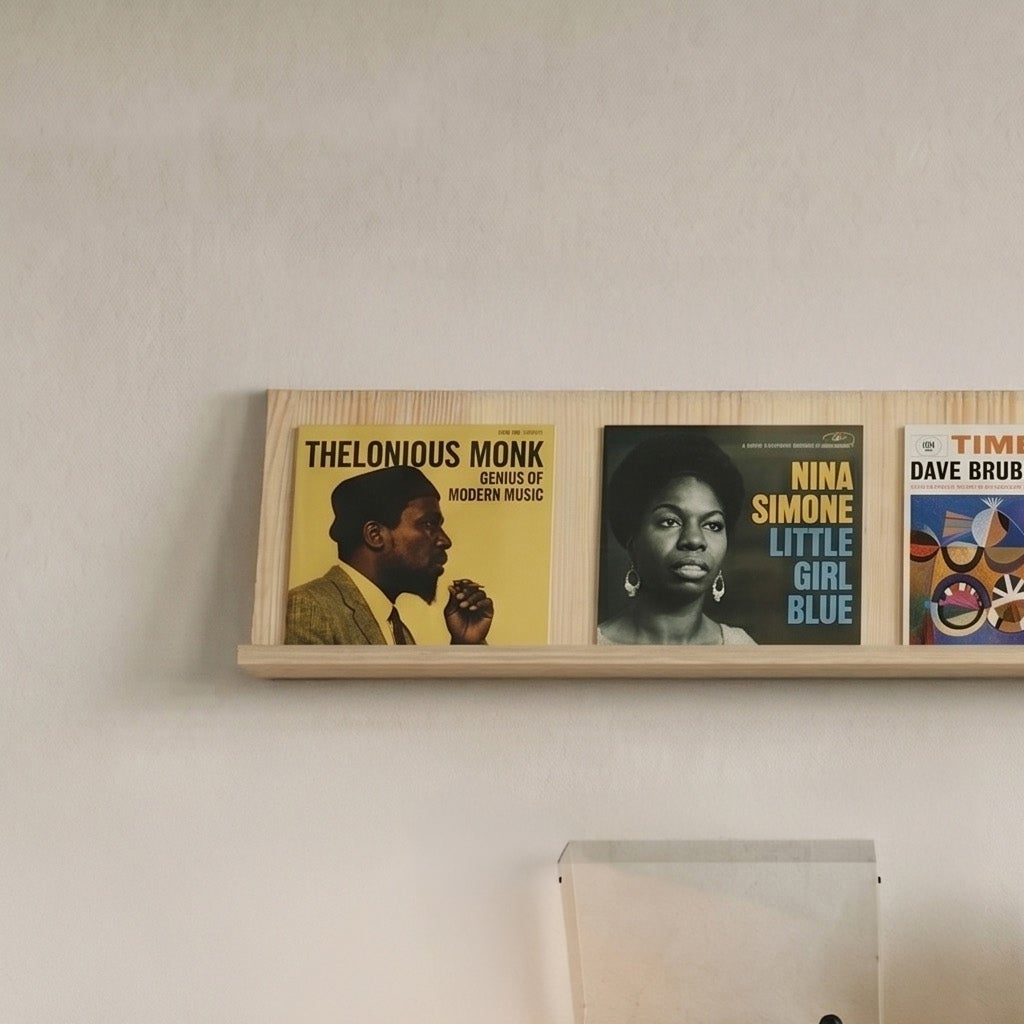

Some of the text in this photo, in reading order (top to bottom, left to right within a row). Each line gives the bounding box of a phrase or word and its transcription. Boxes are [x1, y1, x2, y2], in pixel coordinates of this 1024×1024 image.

[305, 440, 544, 468] THELONIOUS MONK
[479, 470, 544, 486] GENIUS OF
[791, 461, 854, 491] NINA
[910, 460, 961, 481] DAVE
[448, 487, 544, 502] MODERN MUSIC
[751, 493, 854, 524] SIMONE
[769, 527, 854, 557] LITTLE
[793, 560, 853, 591] GIRL
[787, 594, 853, 625] BLUE
